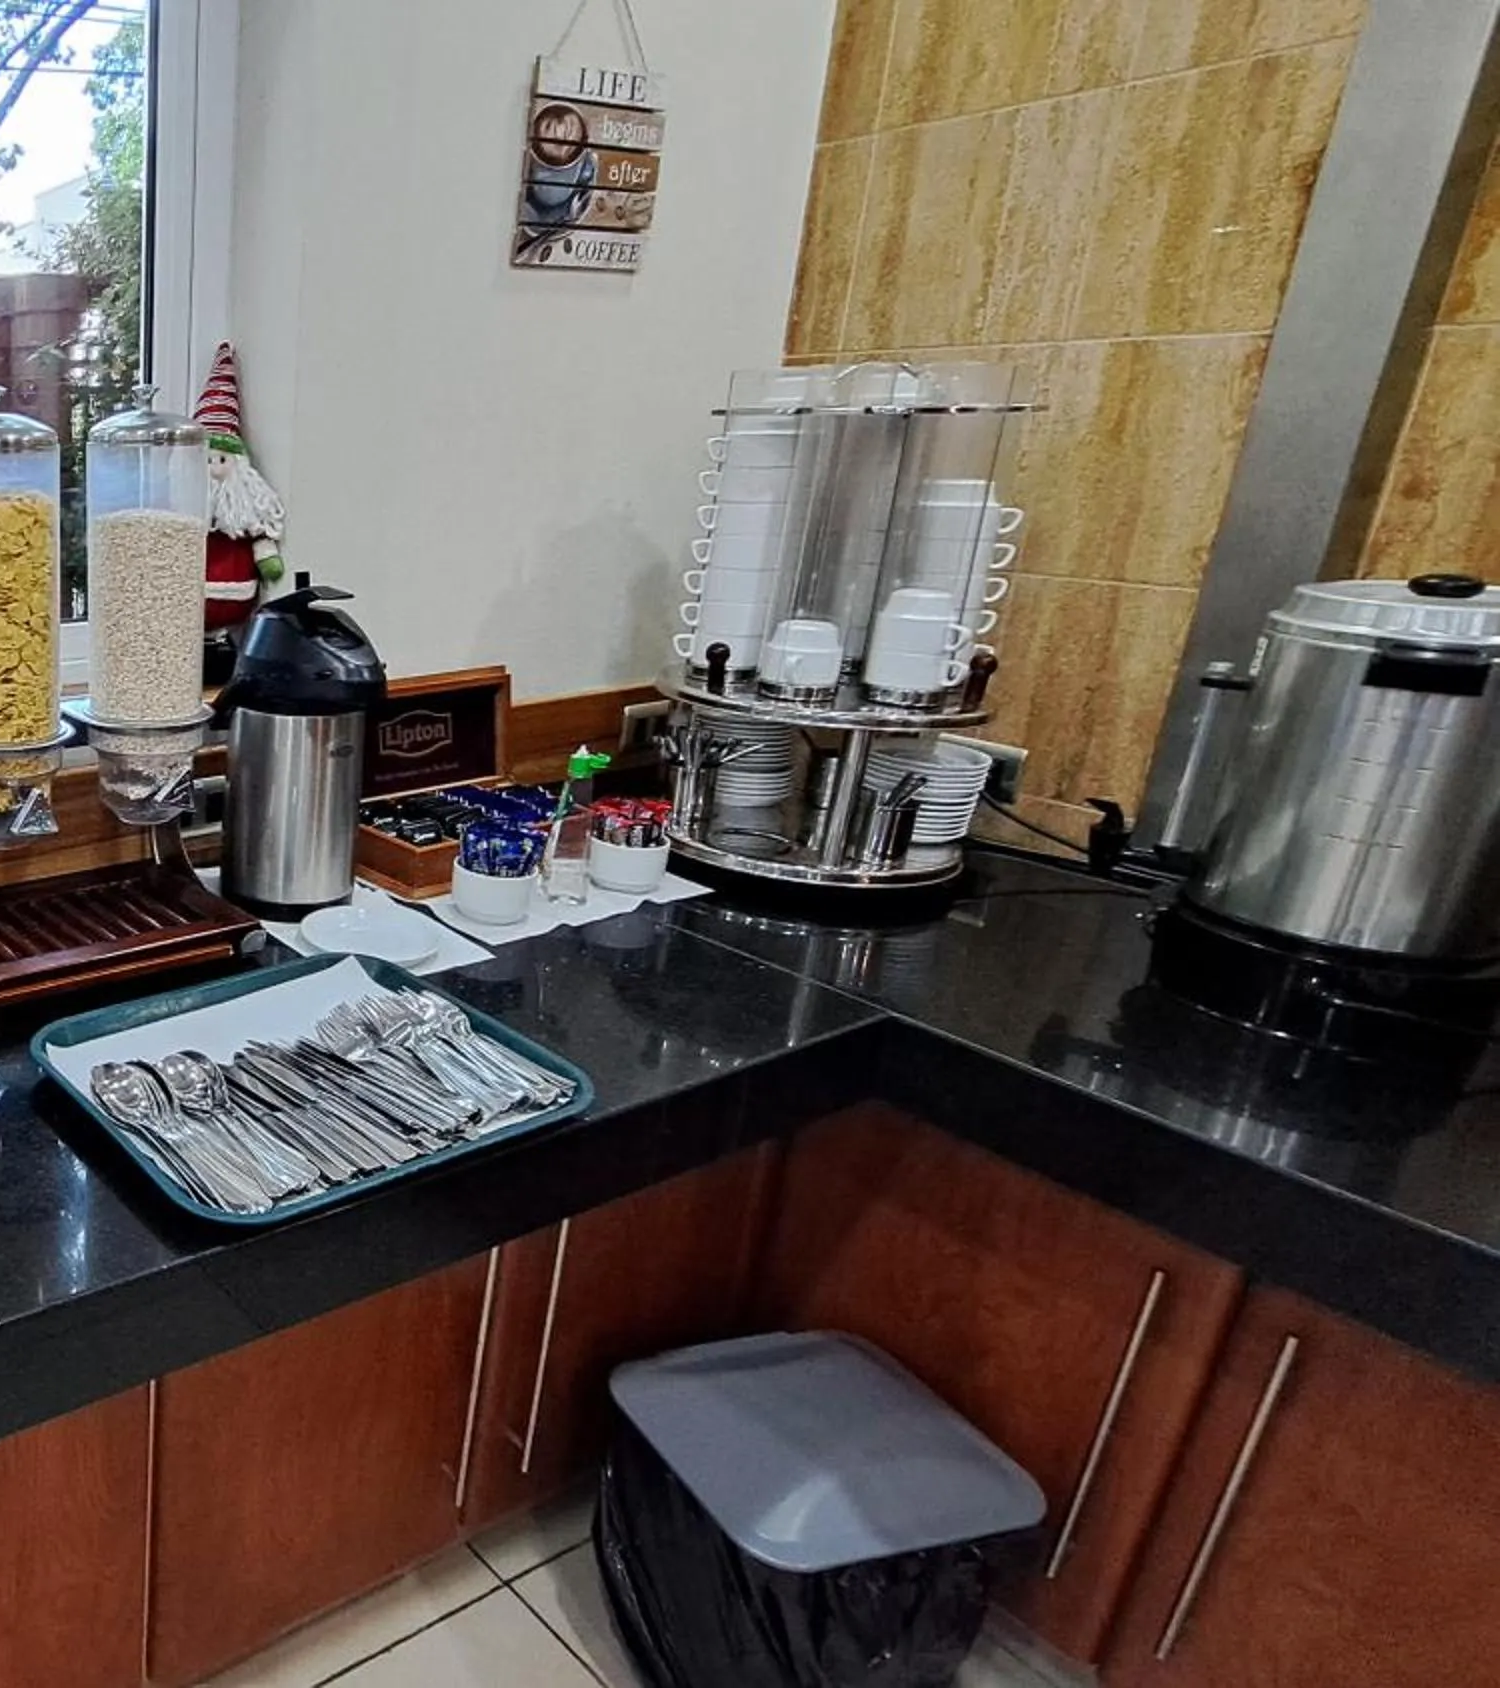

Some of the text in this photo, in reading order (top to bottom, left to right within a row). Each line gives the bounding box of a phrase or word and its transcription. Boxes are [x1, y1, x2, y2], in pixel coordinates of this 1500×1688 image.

[578, 66, 648, 102] LIFE
[608, 159, 652, 187] after
[574, 239, 641, 263] COFFEE
[385, 723, 446, 749] Lipton
